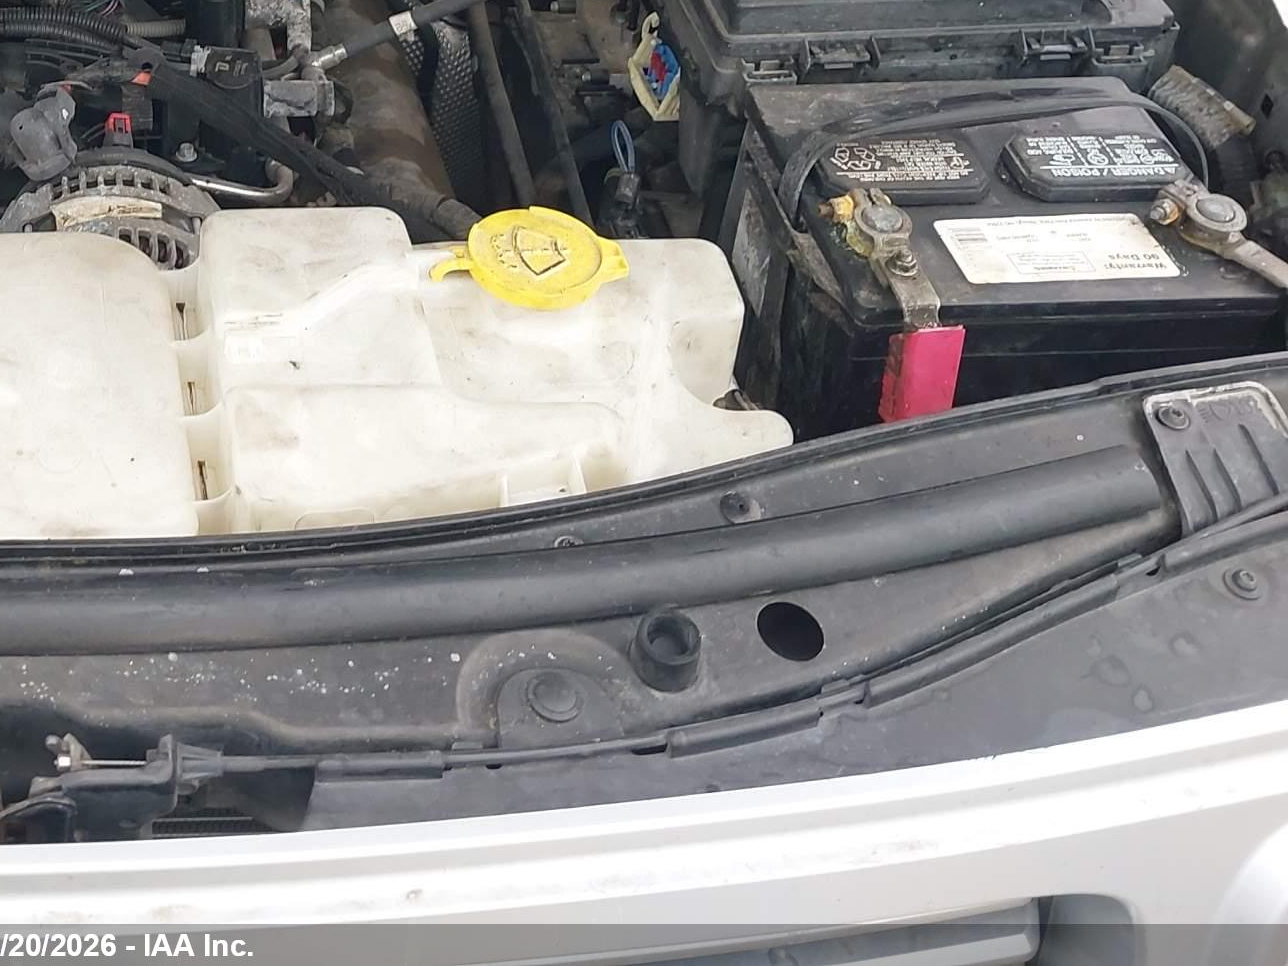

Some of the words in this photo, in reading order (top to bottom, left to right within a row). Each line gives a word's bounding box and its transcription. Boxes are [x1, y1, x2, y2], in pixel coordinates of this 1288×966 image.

[1051, 168, 1100, 177] POISON
[1112, 167, 1162, 176] DANGER
[1108, 253, 1140, 261] Days
[1144, 253, 1160, 261] 90
